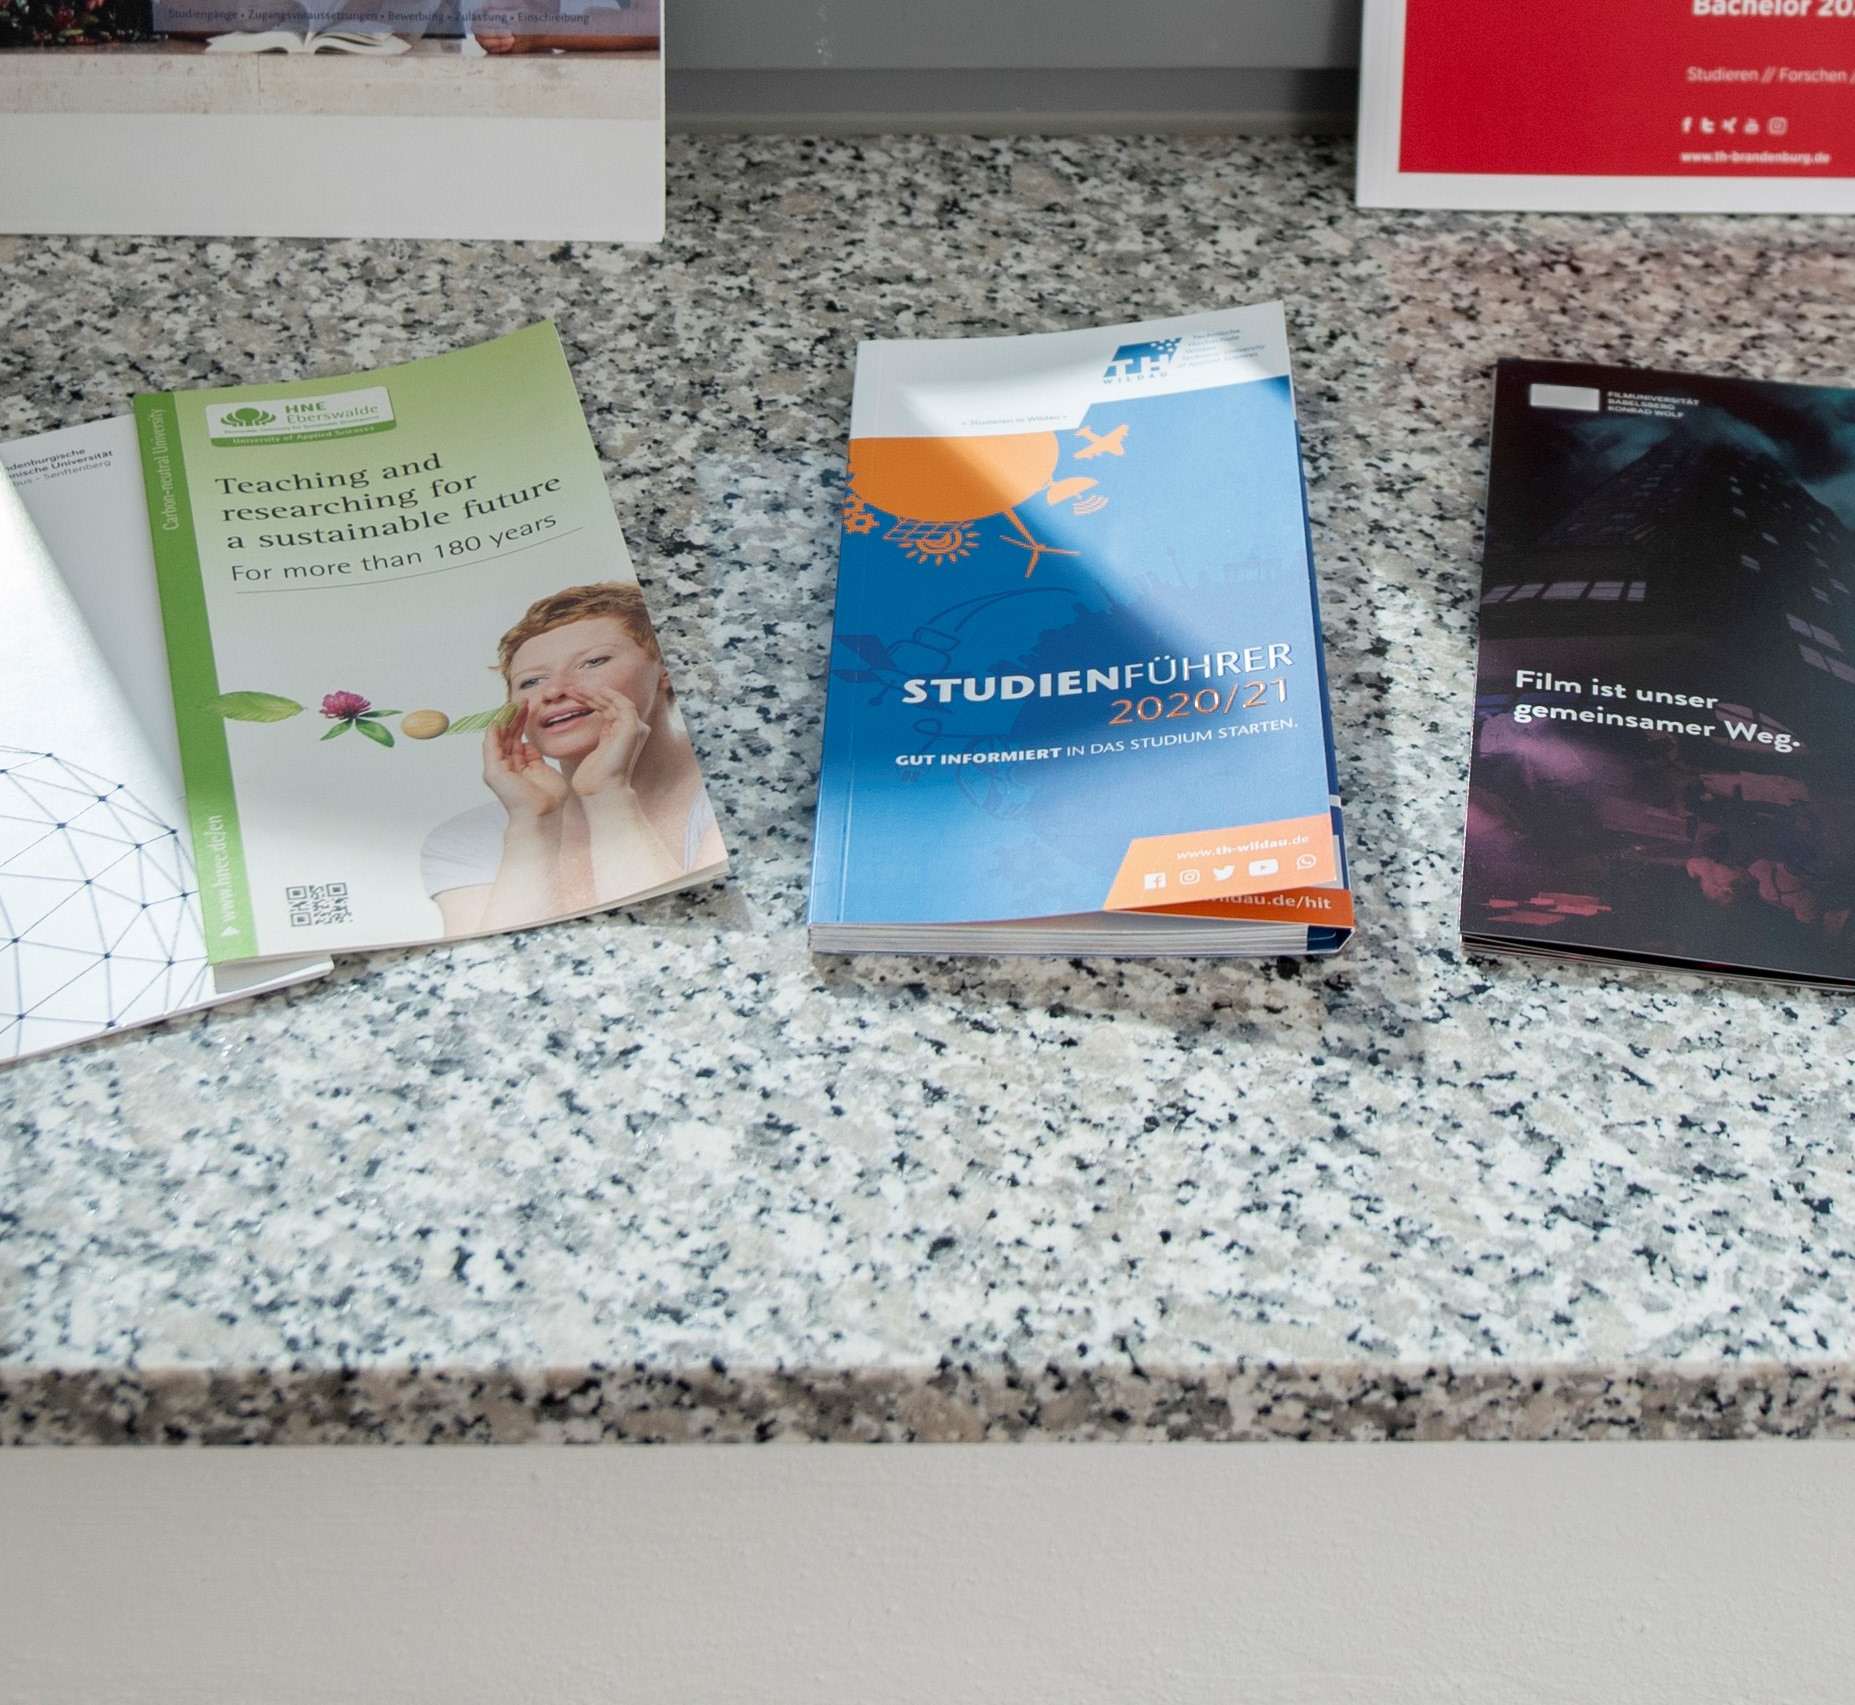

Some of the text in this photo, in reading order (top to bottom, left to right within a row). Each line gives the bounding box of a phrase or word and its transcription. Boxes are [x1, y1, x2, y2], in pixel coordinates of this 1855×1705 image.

[169, 9, 238, 21] Studiengänge
[1687, 67, 1758, 82] Studieren
[1779, 67, 1847, 83] Forschen
[1103, 372, 1167, 384] WILDAU
[285, 402, 326, 413] HNE
[1608, 391, 1700, 406] FILMUNIVERSITÄT
[1608, 398, 1675, 410] BABELSBERG
[287, 405, 378, 424] Eberswalde
[1608, 406, 1685, 418] KONRAD WOLF
[232, 436, 279, 444] University
[297, 431, 332, 441] Applied
[335, 426, 375, 436] Sciences
[4, 449, 85, 471] ndenburgische
[44, 460, 112, 480] Senftenberg
[51, 451, 113, 469] Universität
[148, 409, 179, 530] Carbon-neutral University
[215, 453, 443, 495] Teaching and
[222, 474, 478, 522] researching for
[227, 478, 562, 548] a sustainable future
[232, 513, 557, 581] For more than 180 years
[901, 642, 1294, 703] STUDIENFÜHRER
[1516, 670, 1718, 709] Film ist unser
[1109, 677, 1287, 726] 2020/21
[1514, 704, 1800, 753] gemeinsamer Weg.
[896, 720, 1299, 765] GUT INFORMIERT IN DAS STUDIUM STARTEN.
[1177, 835, 1309, 860] www.th-wildau.de
